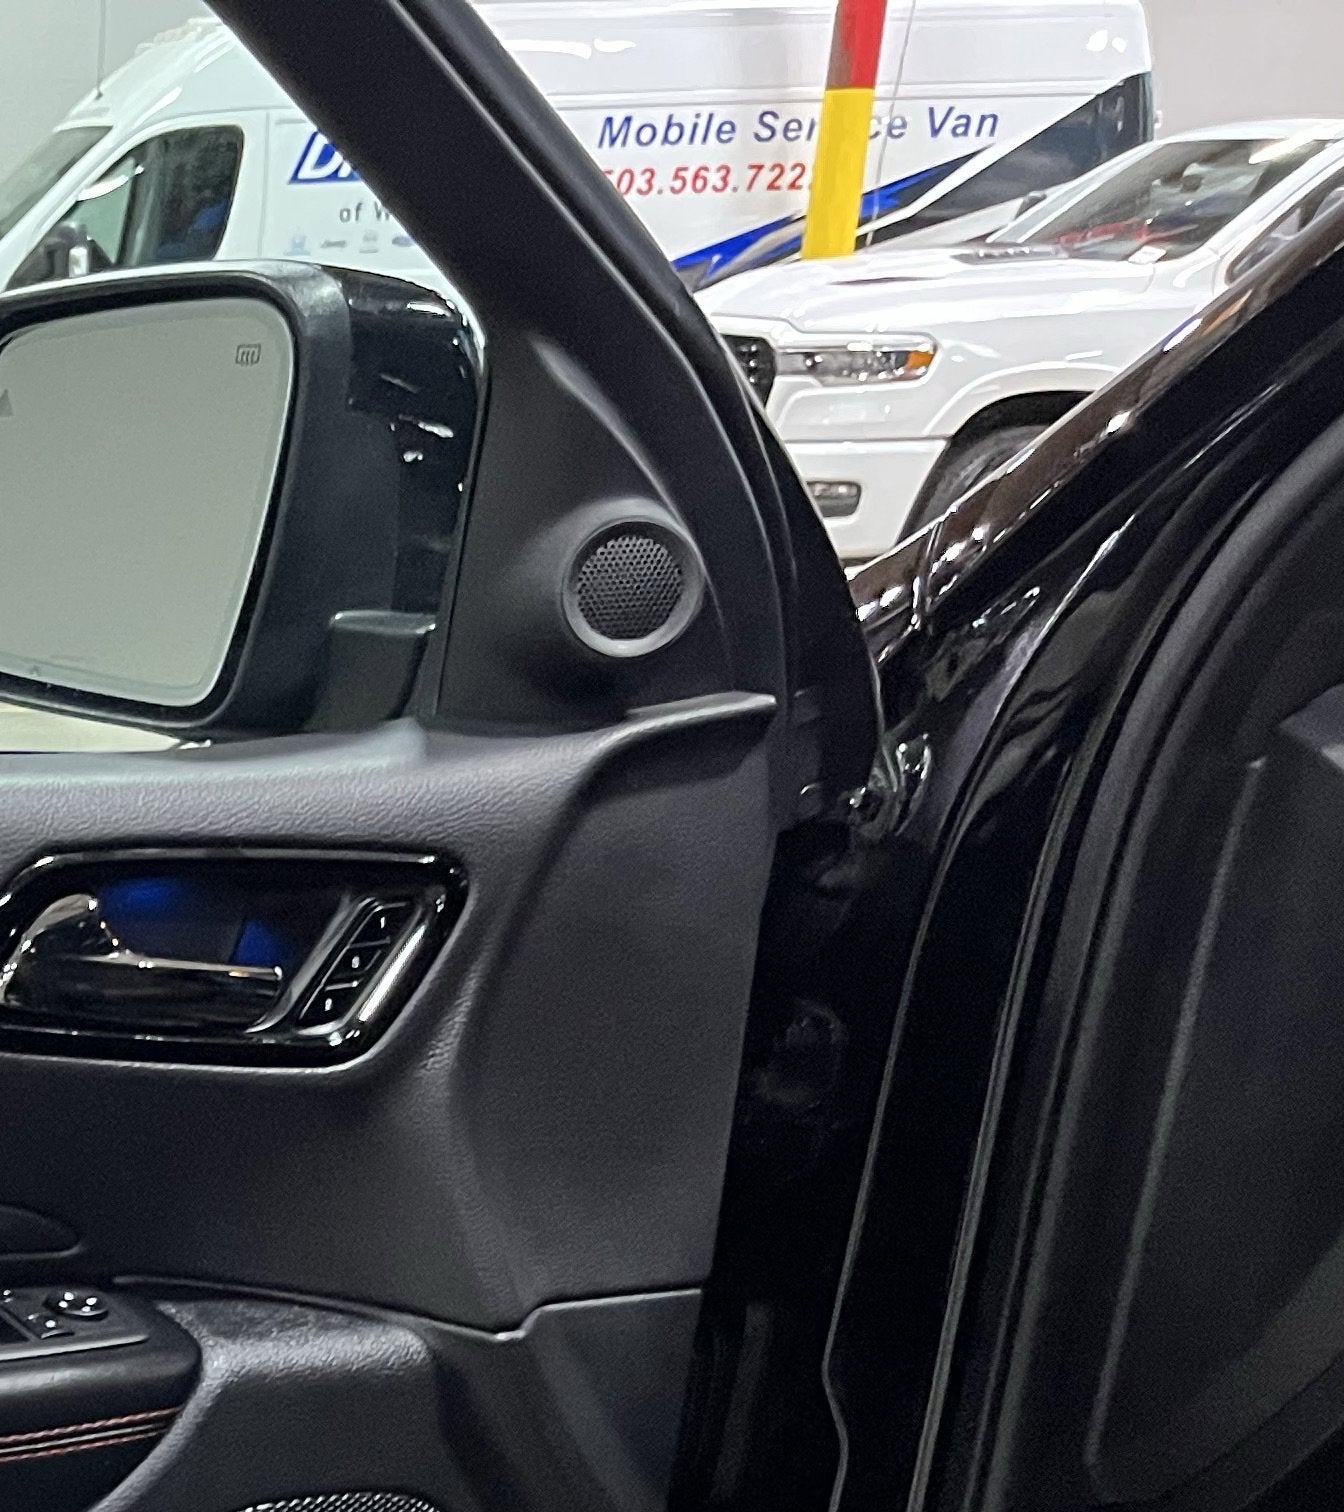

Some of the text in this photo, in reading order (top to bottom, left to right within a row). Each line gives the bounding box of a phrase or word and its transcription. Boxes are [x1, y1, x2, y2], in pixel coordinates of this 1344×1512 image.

[598, 106, 999, 149] Mobile Serce Van
[601, 162, 813, 197] 03.563.722
